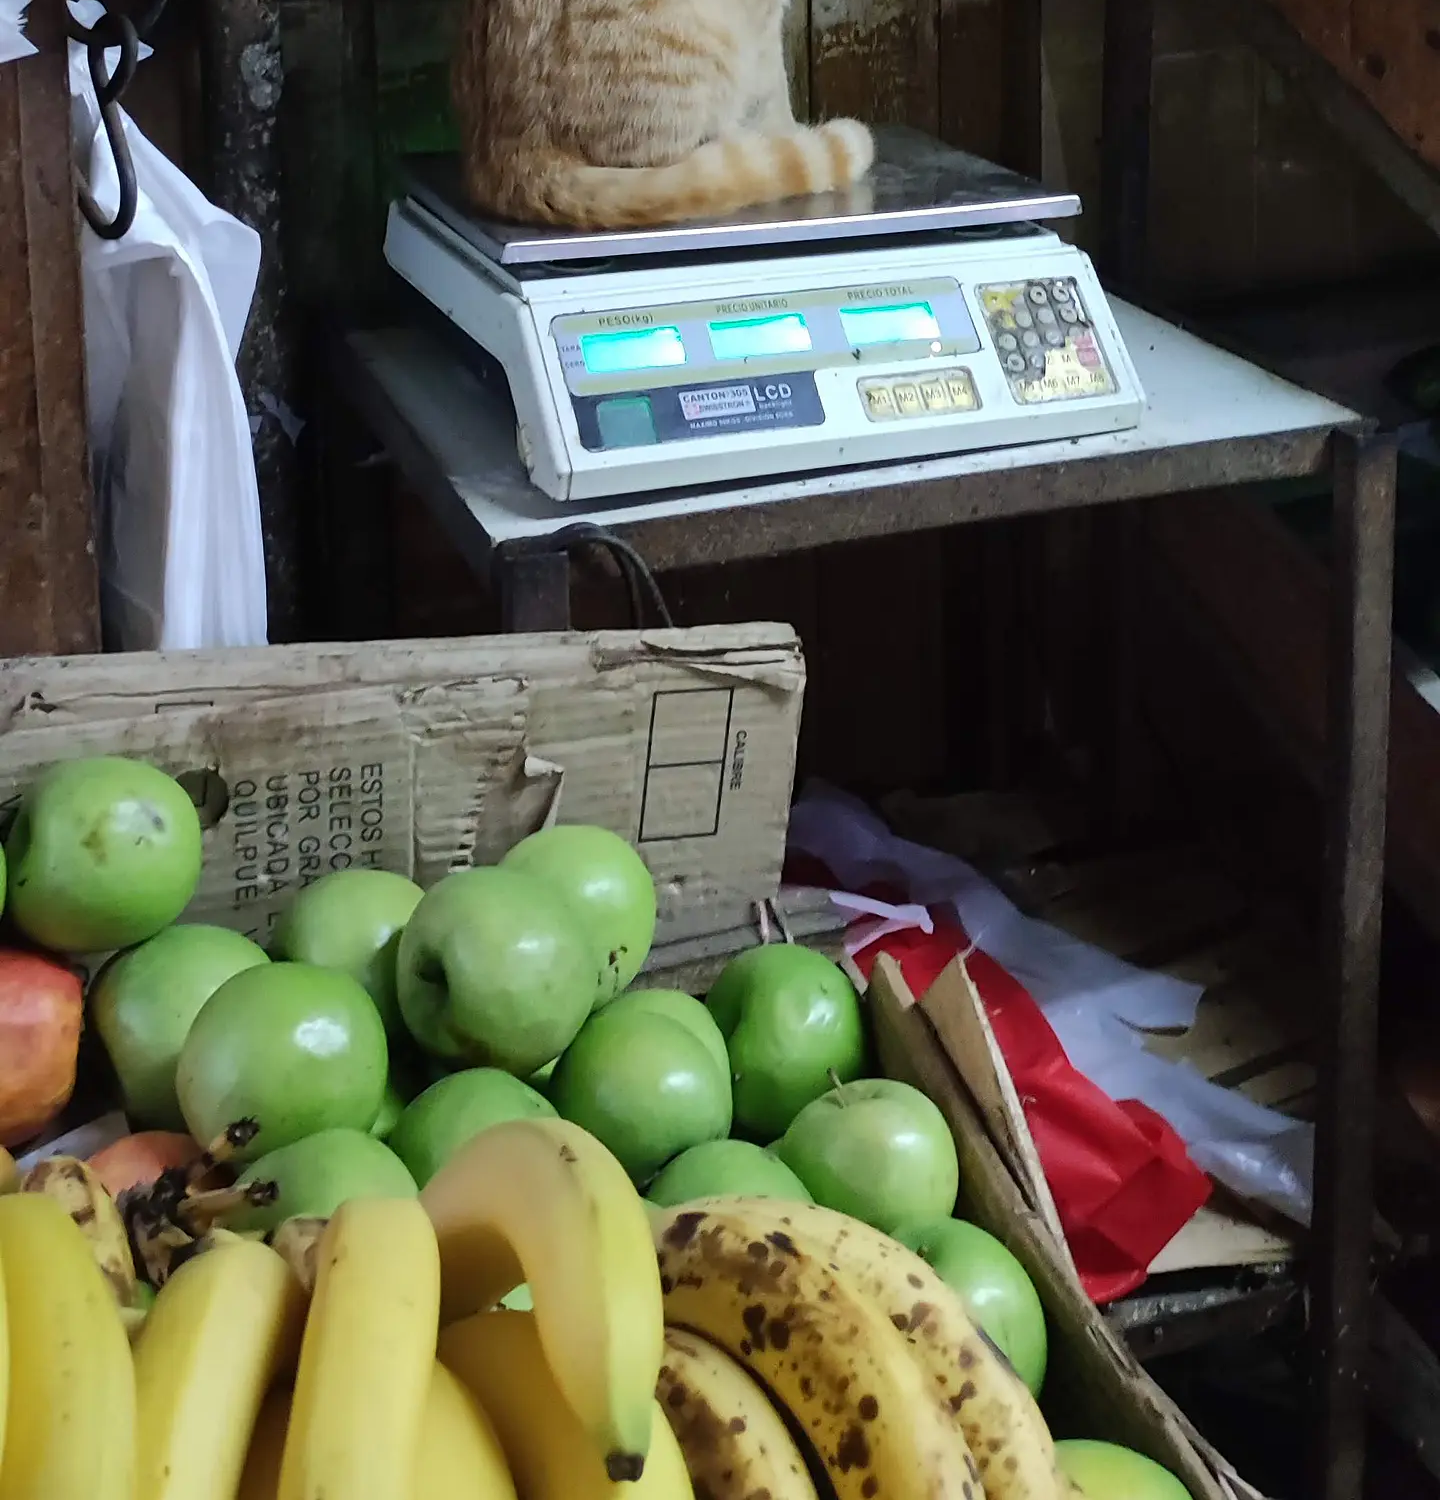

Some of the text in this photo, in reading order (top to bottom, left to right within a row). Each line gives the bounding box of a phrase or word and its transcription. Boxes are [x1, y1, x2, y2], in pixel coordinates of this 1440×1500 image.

[847, 286, 914, 301] PRECIO TOTAL
[716, 299, 788, 314] PRECIO UNITARIO
[598, 313, 654, 327] PESO(kg)
[683, 391, 726, 403] CANTON
[753, 383, 792, 402] LCD
[899, 391, 914, 402] M2
[730, 730, 747, 790] CALIBRE
[329, 767, 352, 869] SELECC
[360, 763, 383, 870] ESTOS H
[266, 774, 290, 895] UBICADA
[298, 770, 320, 888] POR GRA
